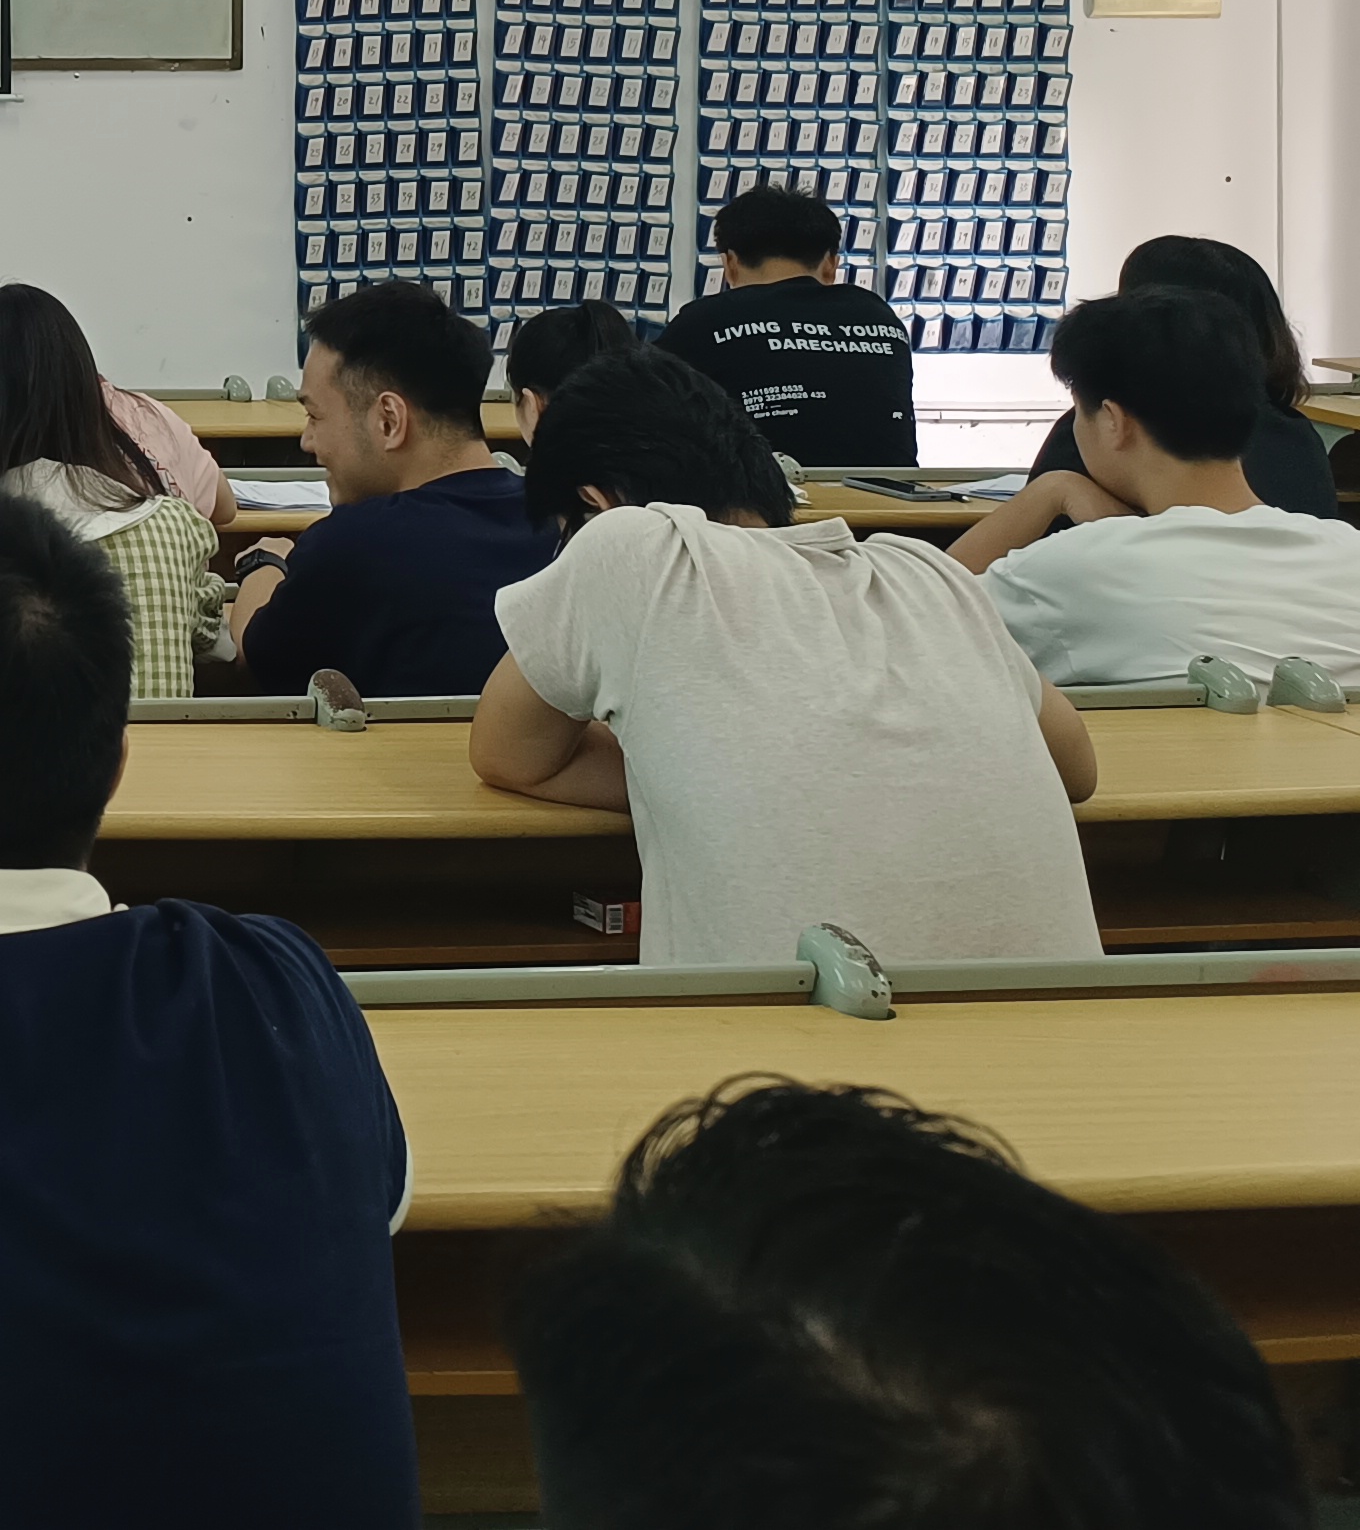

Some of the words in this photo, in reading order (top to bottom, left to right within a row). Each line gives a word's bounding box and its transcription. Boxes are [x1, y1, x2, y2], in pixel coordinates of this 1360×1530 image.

[713, 322, 780, 344] LIVING
[791, 322, 832, 336] FOR
[838, 325, 909, 344] YOURSEL
[767, 338, 894, 355] DARECHARGE
